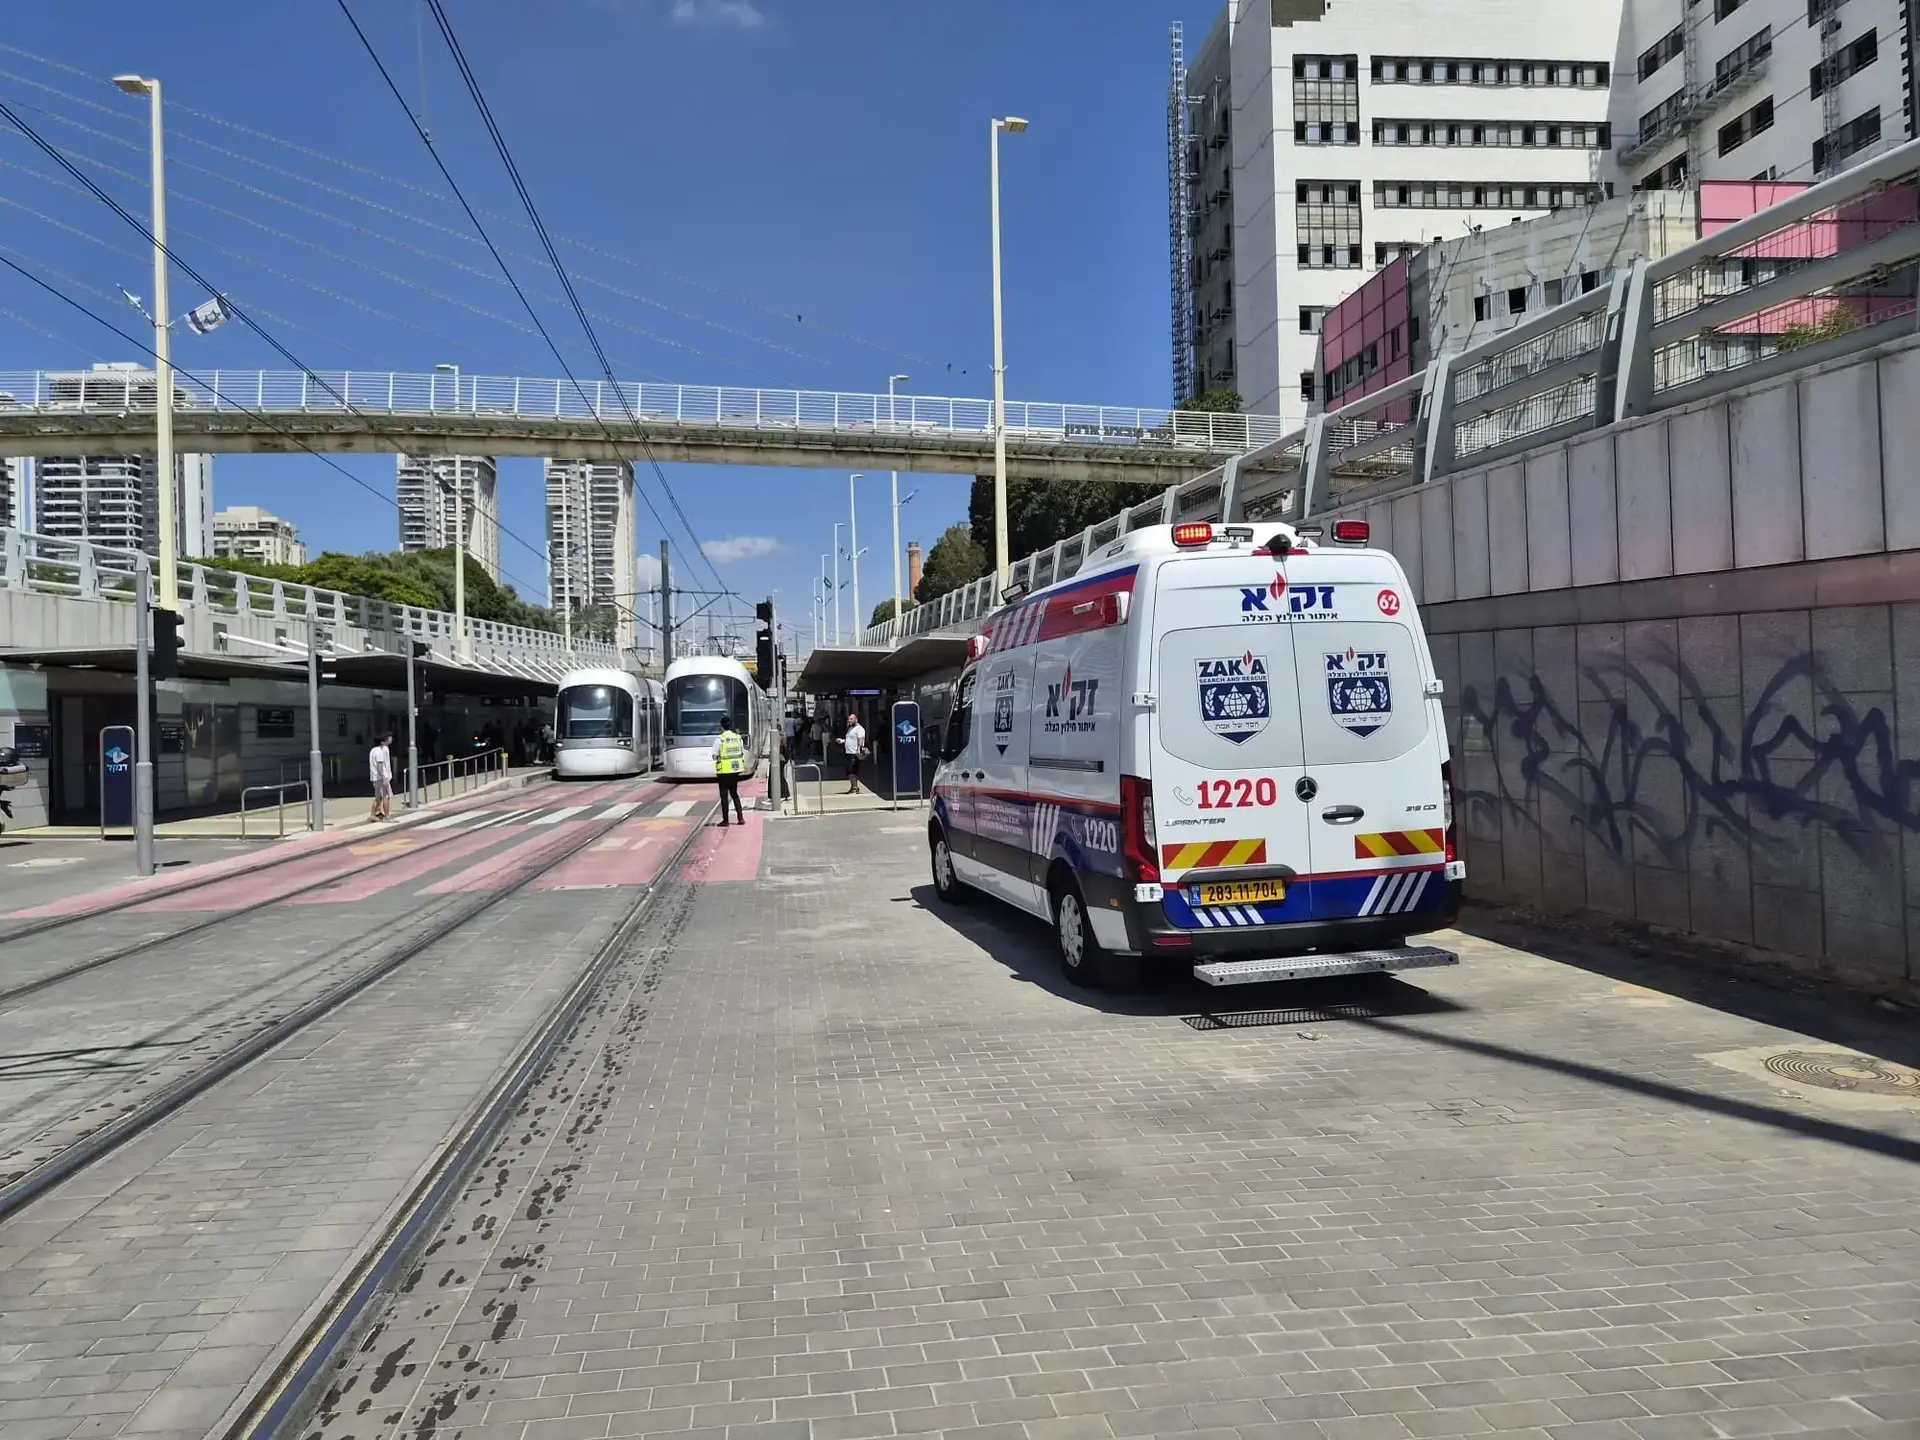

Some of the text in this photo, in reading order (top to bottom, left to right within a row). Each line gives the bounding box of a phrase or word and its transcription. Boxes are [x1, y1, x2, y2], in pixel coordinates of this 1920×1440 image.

[1379, 594, 1399, 610] 62
[1242, 612, 1339, 623] איתור חילוץ הצלה
[1044, 720, 1096, 735] איתור חילוץ הצלה
[106, 764, 128, 774] דנקל
[1197, 777, 1277, 809] 1220
[1084, 818, 1117, 853] 1220
